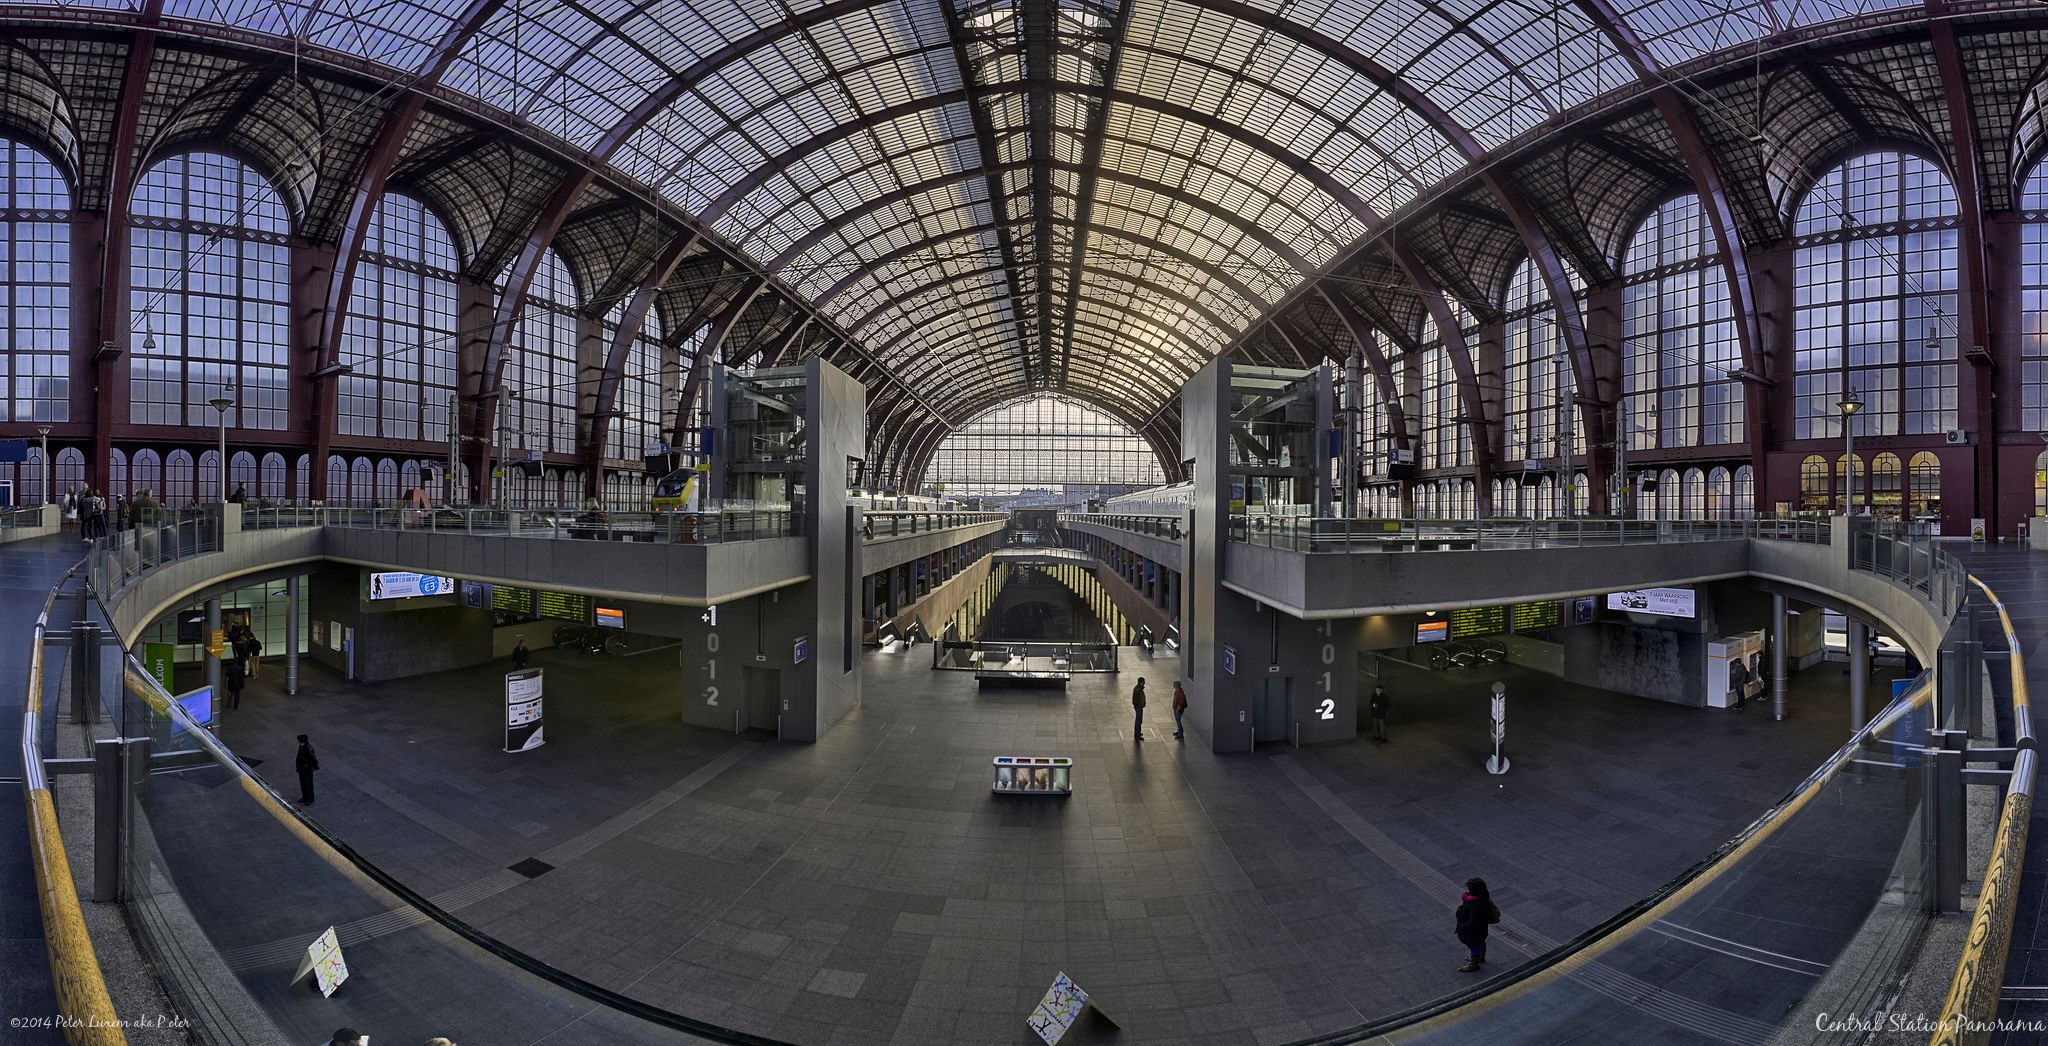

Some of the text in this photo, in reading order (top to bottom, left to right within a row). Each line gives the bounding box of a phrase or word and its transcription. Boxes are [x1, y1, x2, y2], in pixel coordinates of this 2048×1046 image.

[701, 605, 717, 626] +1
[1316, 619, 1331, 636] +1
[707, 632, 720, 652] 0
[1322, 643, 1335, 664] 0
[1315, 698, 1335, 719] -2
